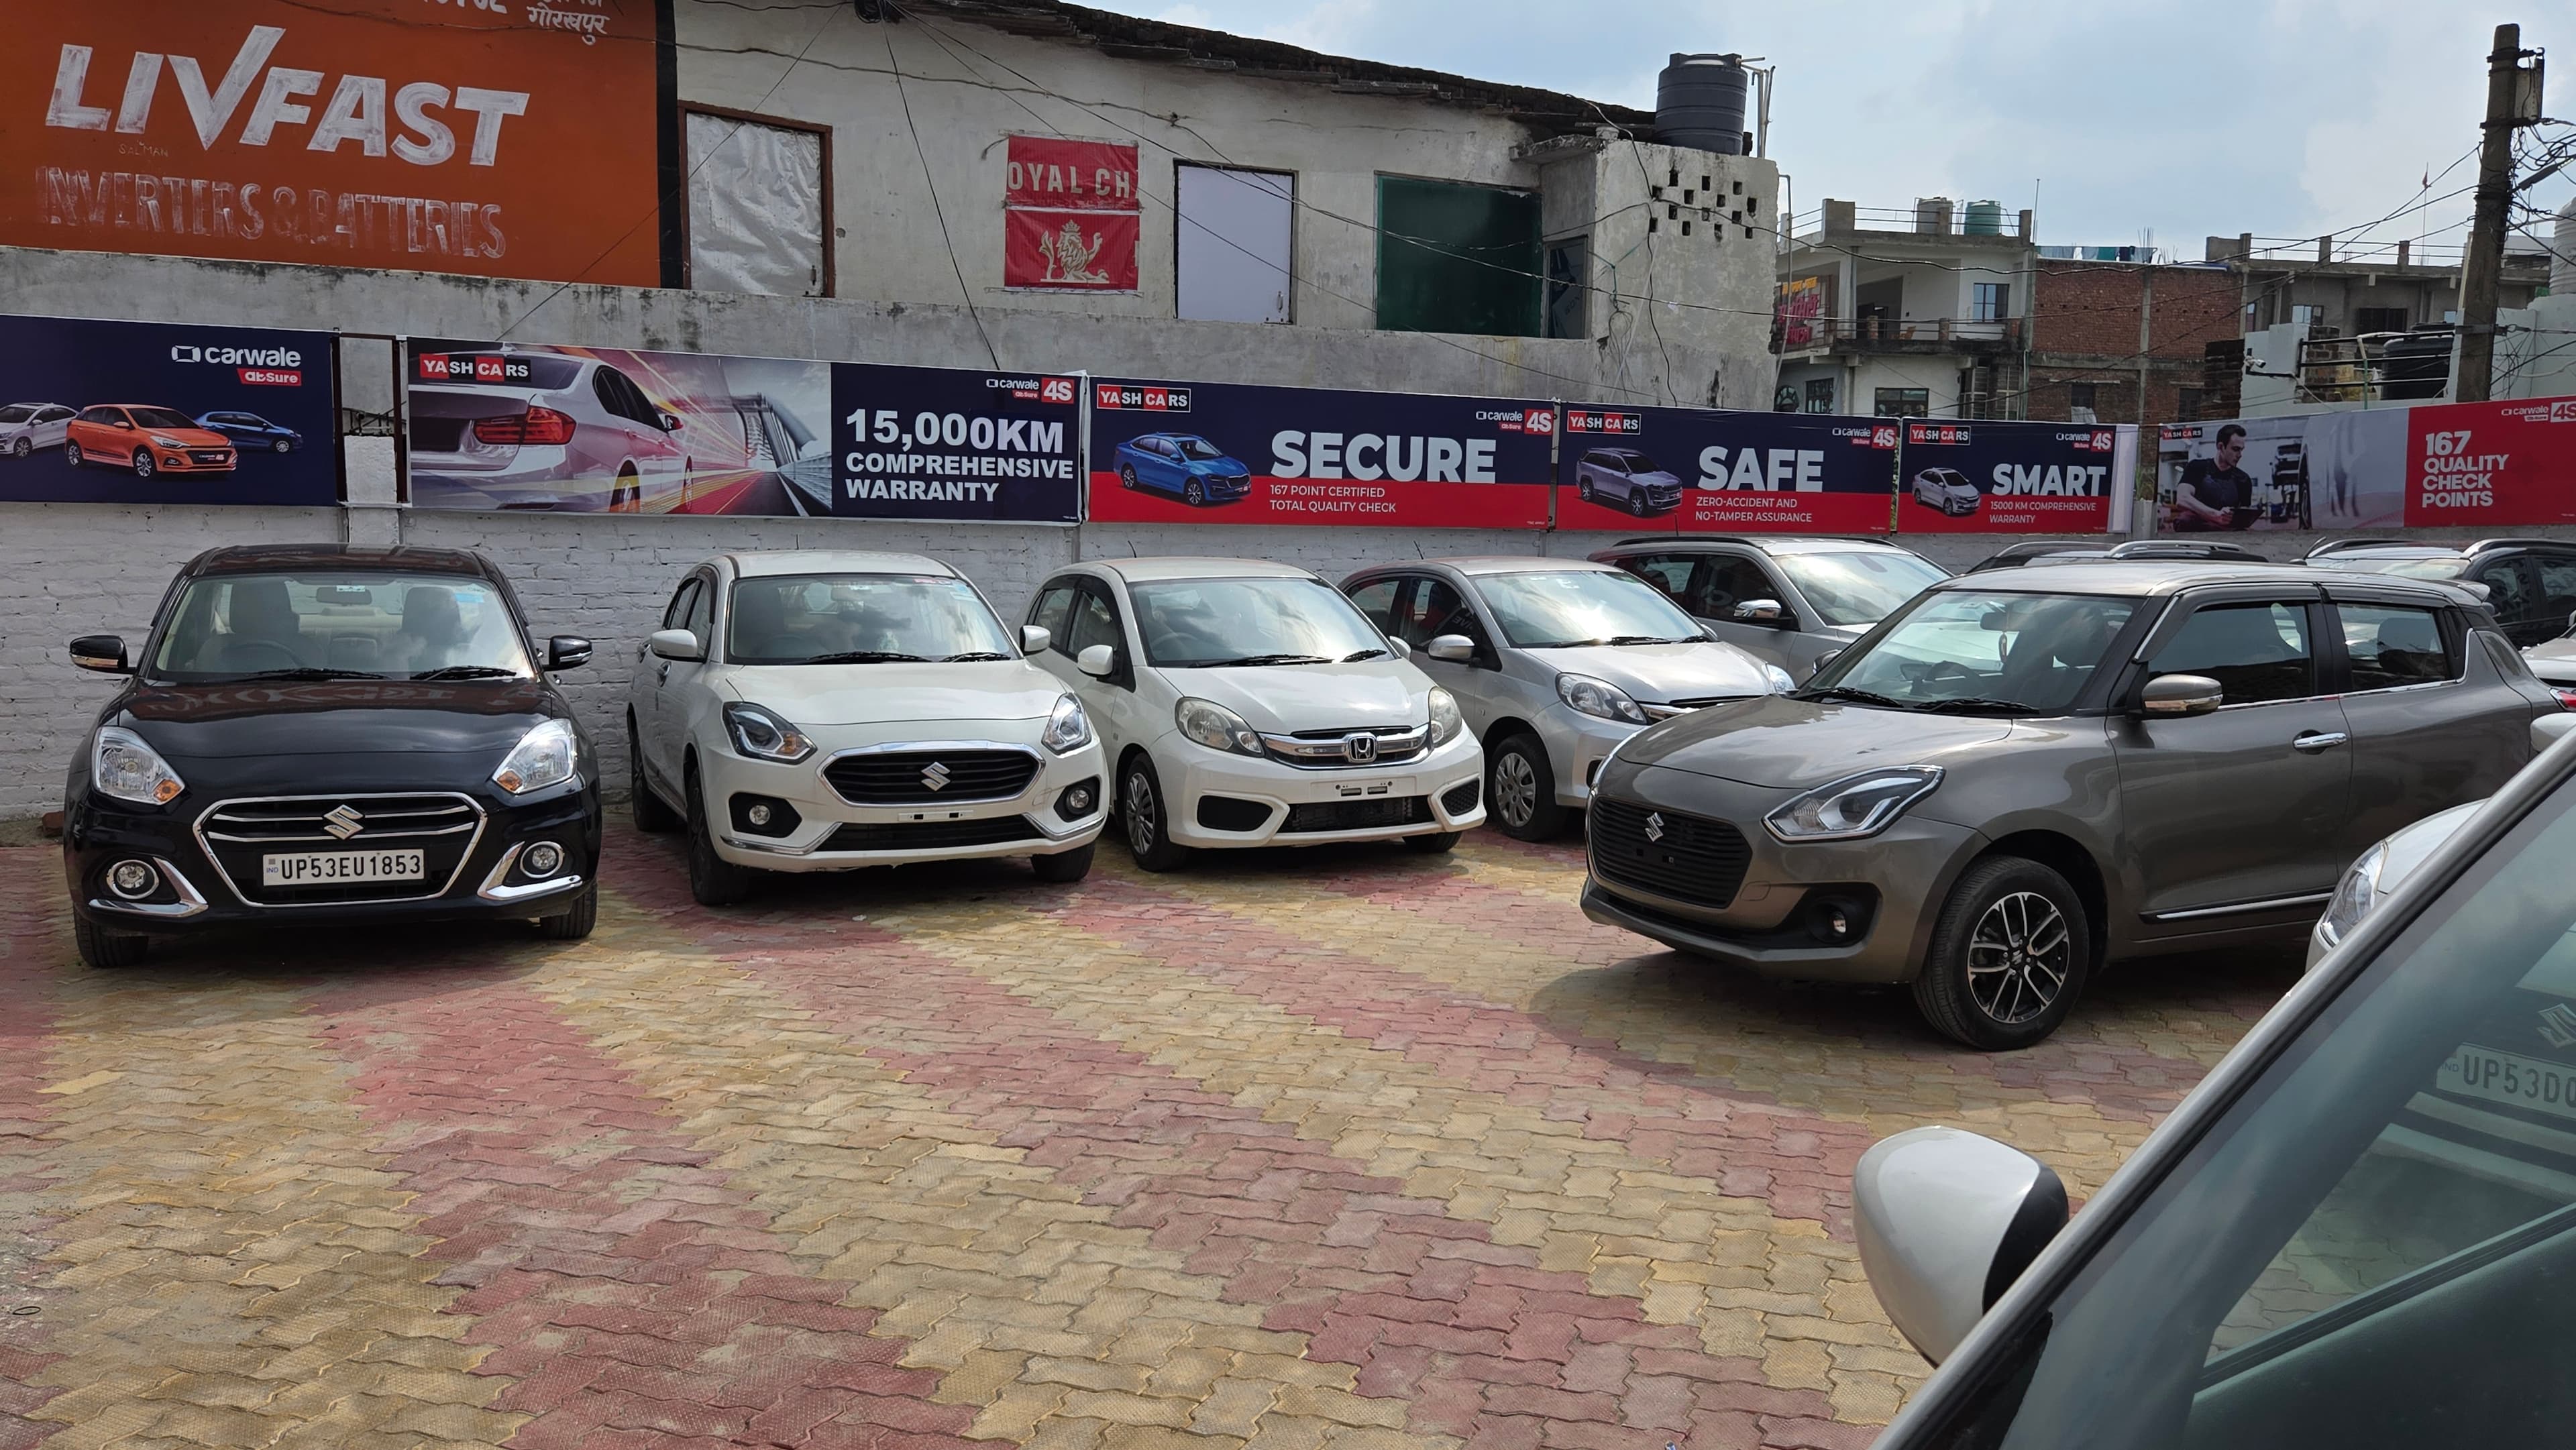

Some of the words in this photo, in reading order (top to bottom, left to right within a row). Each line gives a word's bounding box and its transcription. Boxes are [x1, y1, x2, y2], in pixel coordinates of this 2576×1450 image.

[527, 2, 610, 45] गोरखपुर
[45, 25, 529, 167] LIVFAST
[1008, 162, 1083, 194] OYAL
[1095, 168, 1138, 199] CH
[35, 166, 263, 240] INVERTERS
[274, 186, 297, 241] &
[309, 188, 506, 259] BATTERIES
[205, 346, 301, 367] carwale
[423, 359, 473, 374] YASH
[478, 362, 529, 377] CARS
[1000, 380, 1039, 390] carwale
[1044, 381, 1072, 401] 4S
[1100, 390, 1142, 406] YASH
[1145, 392, 1188, 408] CARS
[2513, 406, 2548, 415] carwale
[2553, 403, 2576, 419] 4S
[846, 408, 1063, 453] 15,000KM
[1488, 411, 1523, 421] carwale
[1526, 412, 1552, 433] 4S
[1570, 416, 1603, 428] YASH
[1605, 418, 1639, 430] CARS
[1873, 429, 1895, 447] 4S
[1912, 429, 1939, 440] YASH
[1941, 430, 1969, 441] CARS
[2092, 433, 2112, 450] 4S
[2426, 431, 2471, 455] 167
[846, 452, 1073, 479] COMPREHENSIVE
[1271, 430, 1497, 484] SECURE
[2424, 454, 2510, 474] QUALITY
[1697, 445, 1825, 493] SAFE
[1992, 463, 2106, 496] SMART
[2422, 473, 2492, 490] CHECK
[845, 479, 999, 502] WARRANTY
[1270, 484, 1287, 496] 167
[1291, 485, 1325, 497] POINT
[1328, 486, 1385, 498] CERTIFIED
[2422, 491, 2493, 508] POINTS
[1270, 499, 1305, 511] TOTAL
[1308, 500, 1355, 514] QUALITY
[1358, 502, 1396, 514] CHECK
[1696, 496, 1774, 508] ZERO-ACCIDENT
[1777, 499, 1798, 508] AND
[1990, 501, 2013, 510] 15000
[2015, 502, 2028, 510] KM
[2029, 502, 2096, 511] COMPREHENSIVE
[1695, 512, 1753, 522] NO-TAMPER
[1756, 512, 1813, 522] ASSURANCE
[1990, 515, 2035, 524] WARRANTY
[282, 855, 421, 879] UP53EU1853
